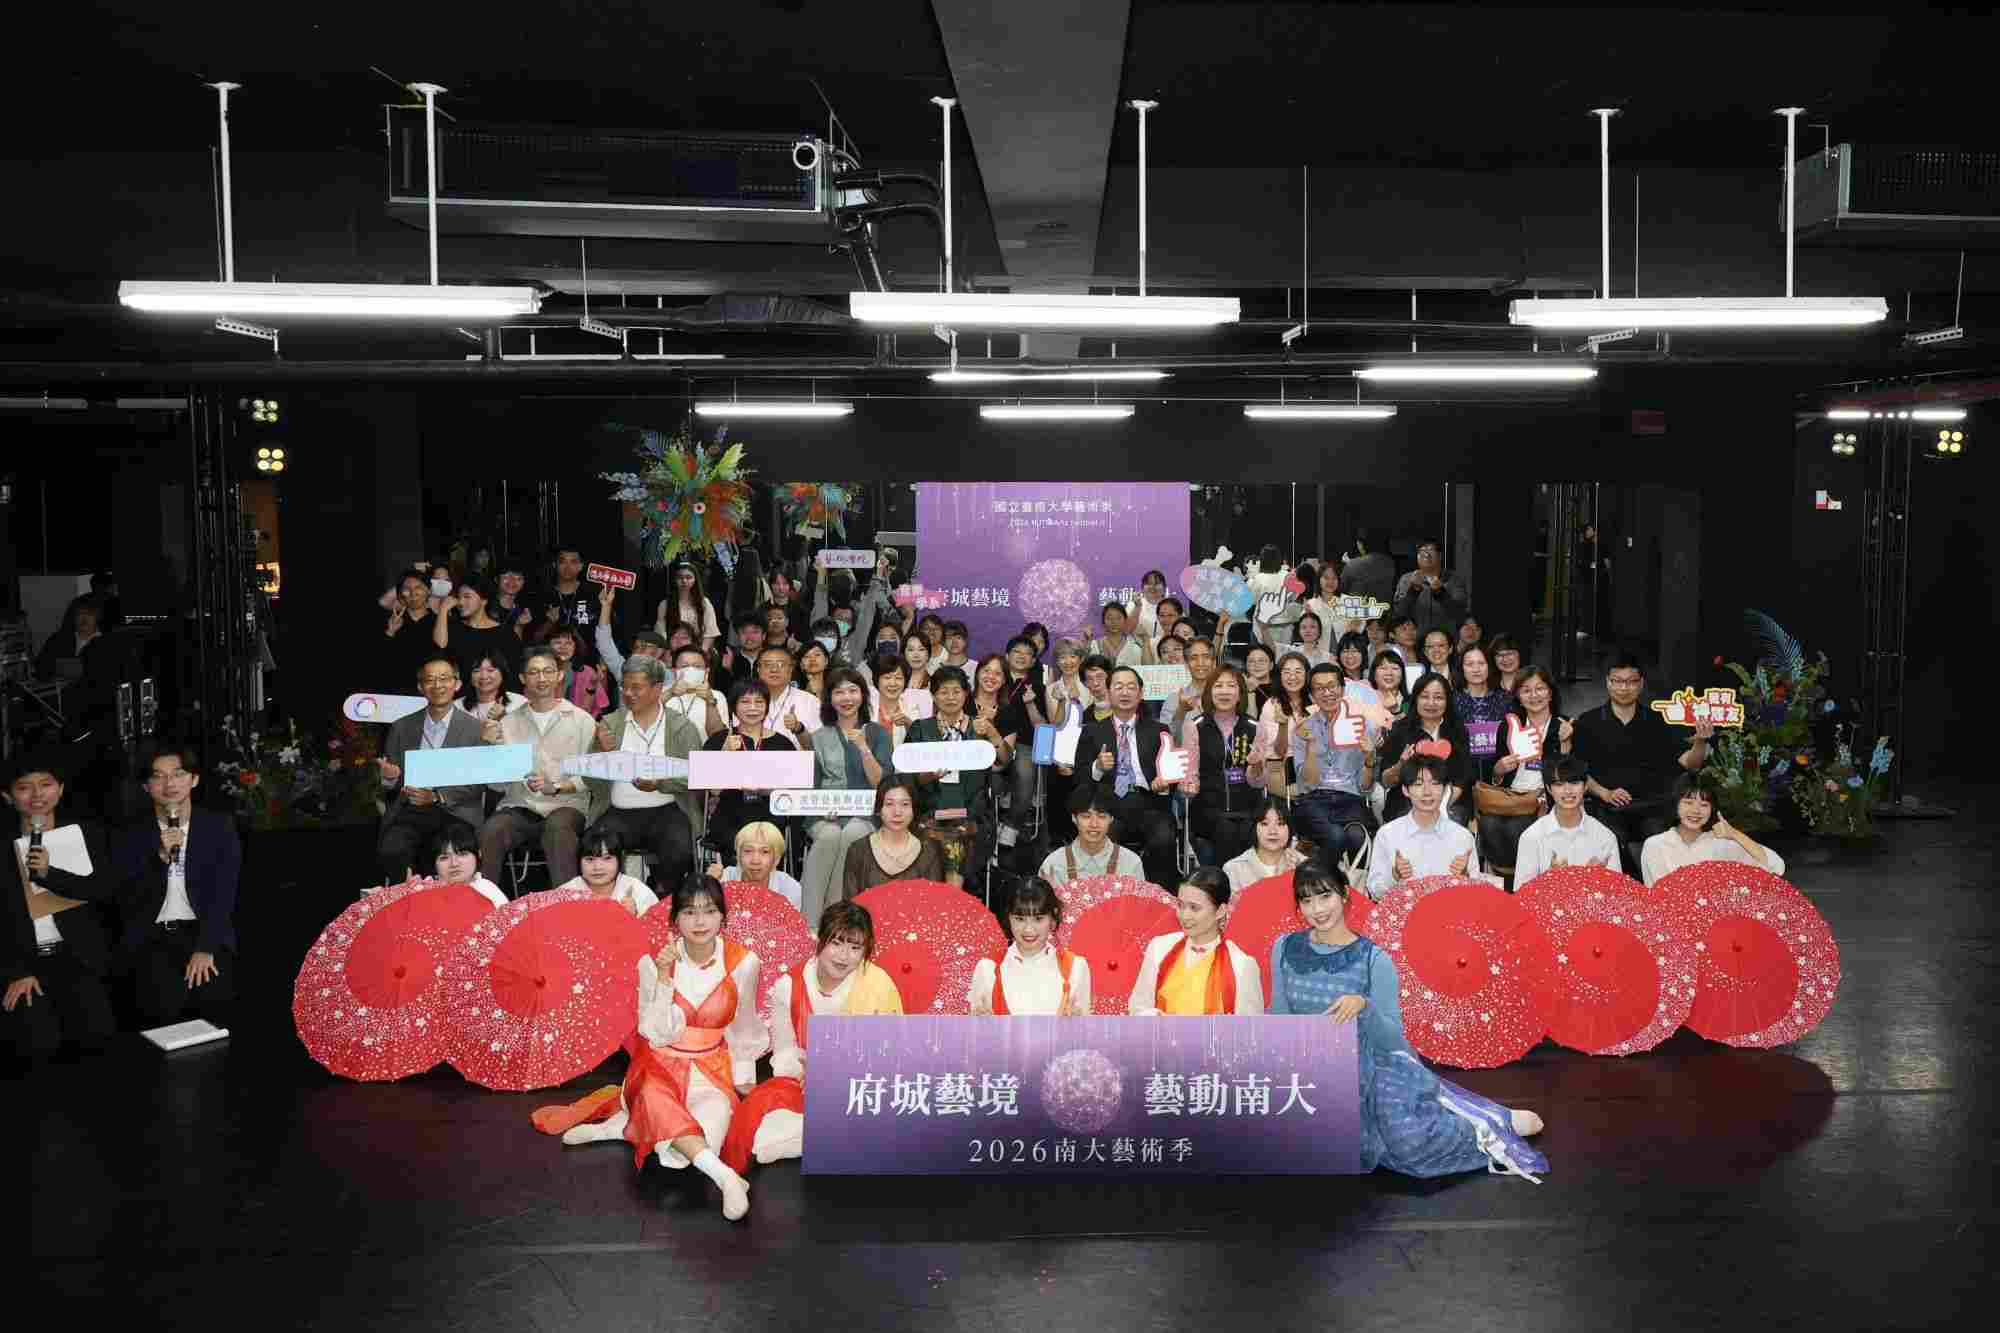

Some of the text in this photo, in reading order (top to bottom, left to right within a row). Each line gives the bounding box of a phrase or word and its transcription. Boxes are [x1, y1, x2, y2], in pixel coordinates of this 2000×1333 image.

[845, 1072, 1318, 1117] 府城藝境 藝動南大
[968, 1136, 1194, 1164] 2026南大藝術季
